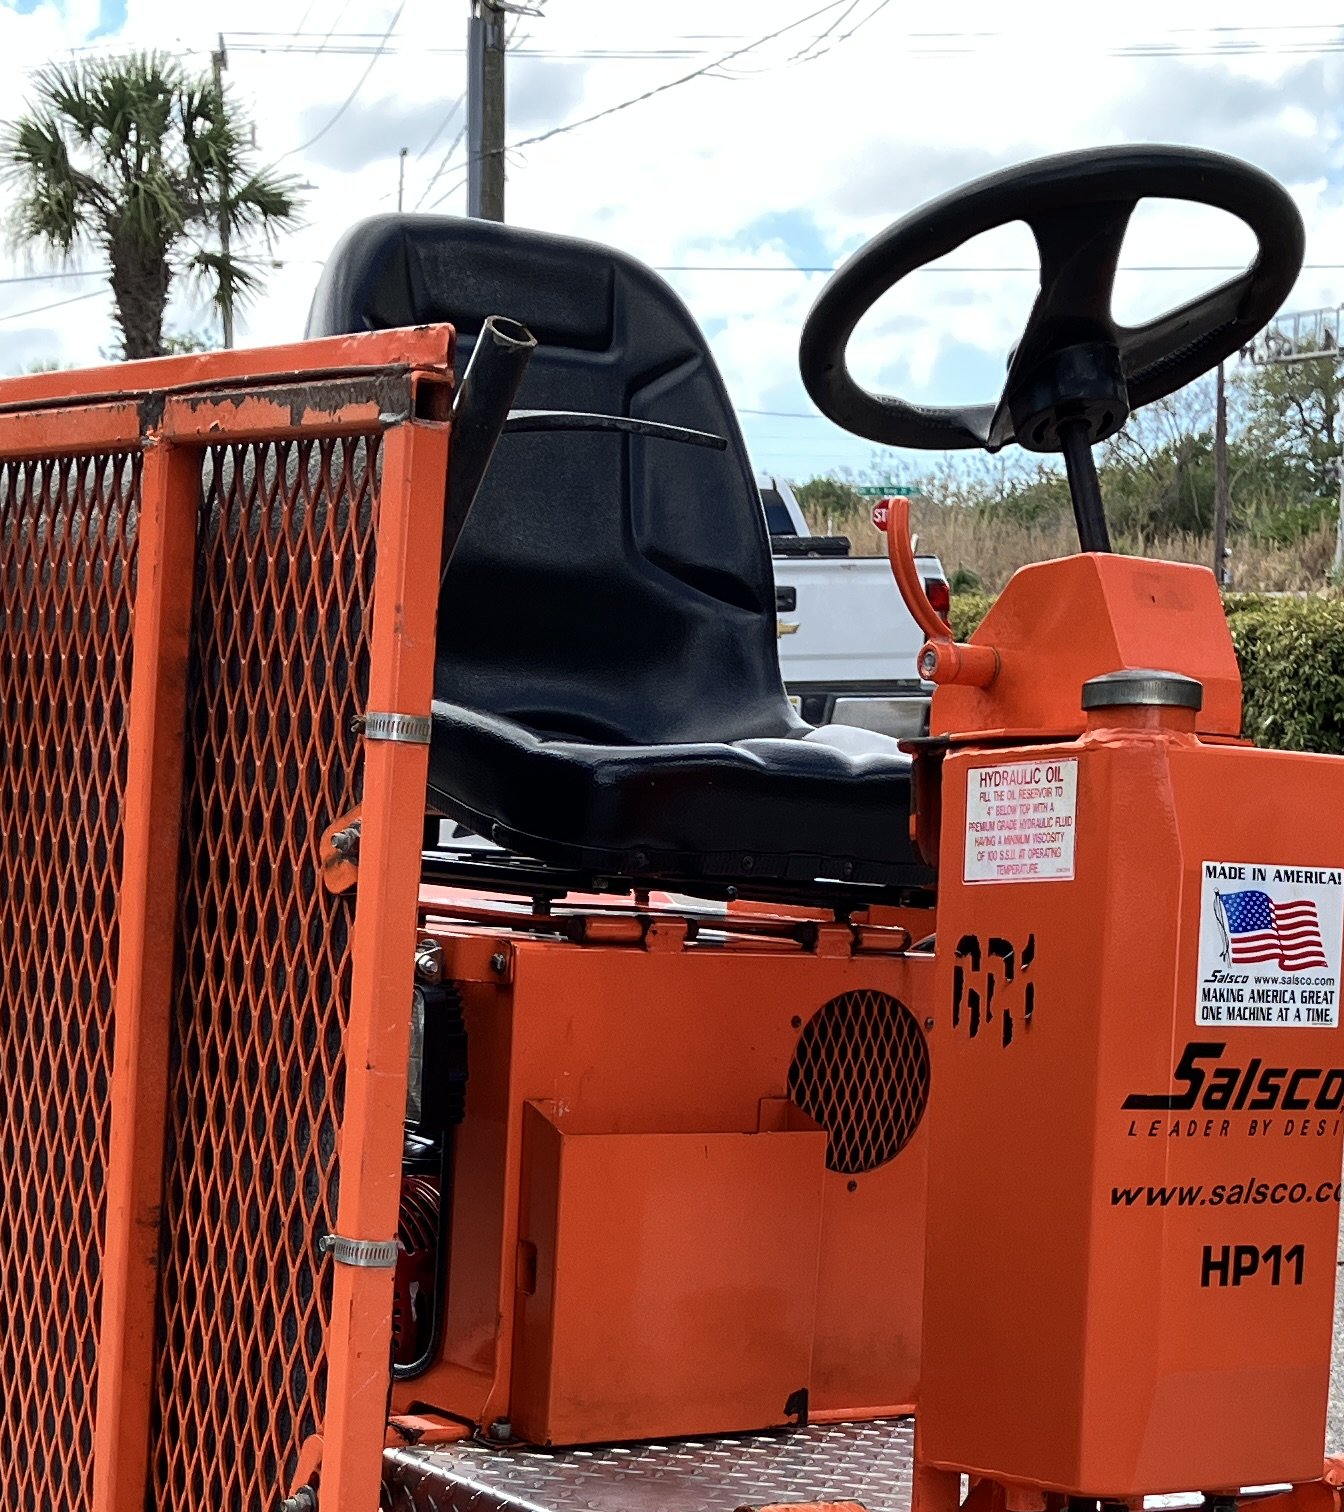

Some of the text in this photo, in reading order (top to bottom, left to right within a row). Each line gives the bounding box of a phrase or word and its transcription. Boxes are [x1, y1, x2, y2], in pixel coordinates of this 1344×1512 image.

[979, 766, 1064, 788] HYDRAULIC OIL
[979, 786, 1063, 802] FILL THE OIL RESERVOIR TO
[996, 804, 1016, 816] BELOW
[1019, 803, 1031, 815] TOP
[1033, 802, 1048, 814] WITH
[1050, 802, 1055, 812] A
[968, 815, 1072, 832] PREMIUM GRADE HYDRAULIC FLUID
[975, 832, 1065, 847] HAVING A MINIMUM VISCOSITY
[977, 851, 985, 862] OF
[987, 850, 998, 861] 100
[1019, 848, 1026, 859] AT
[1028, 847, 1062, 859] OPERATING
[1205, 866, 1342, 885] MADE IN AMERICA!
[1204, 970, 1335, 986] Salsco www.salsco.com
[1202, 987, 1335, 1005] MAKING AMERICA GREAT
[1201, 1006, 1333, 1023] ONE MACHINE AT A TIME.
[1128, 1119, 1344, 1137] LEADER BY DESI
[1111, 1178, 1341, 1206] www.salsco.c
[1201, 1244, 1305, 1287] HP11
